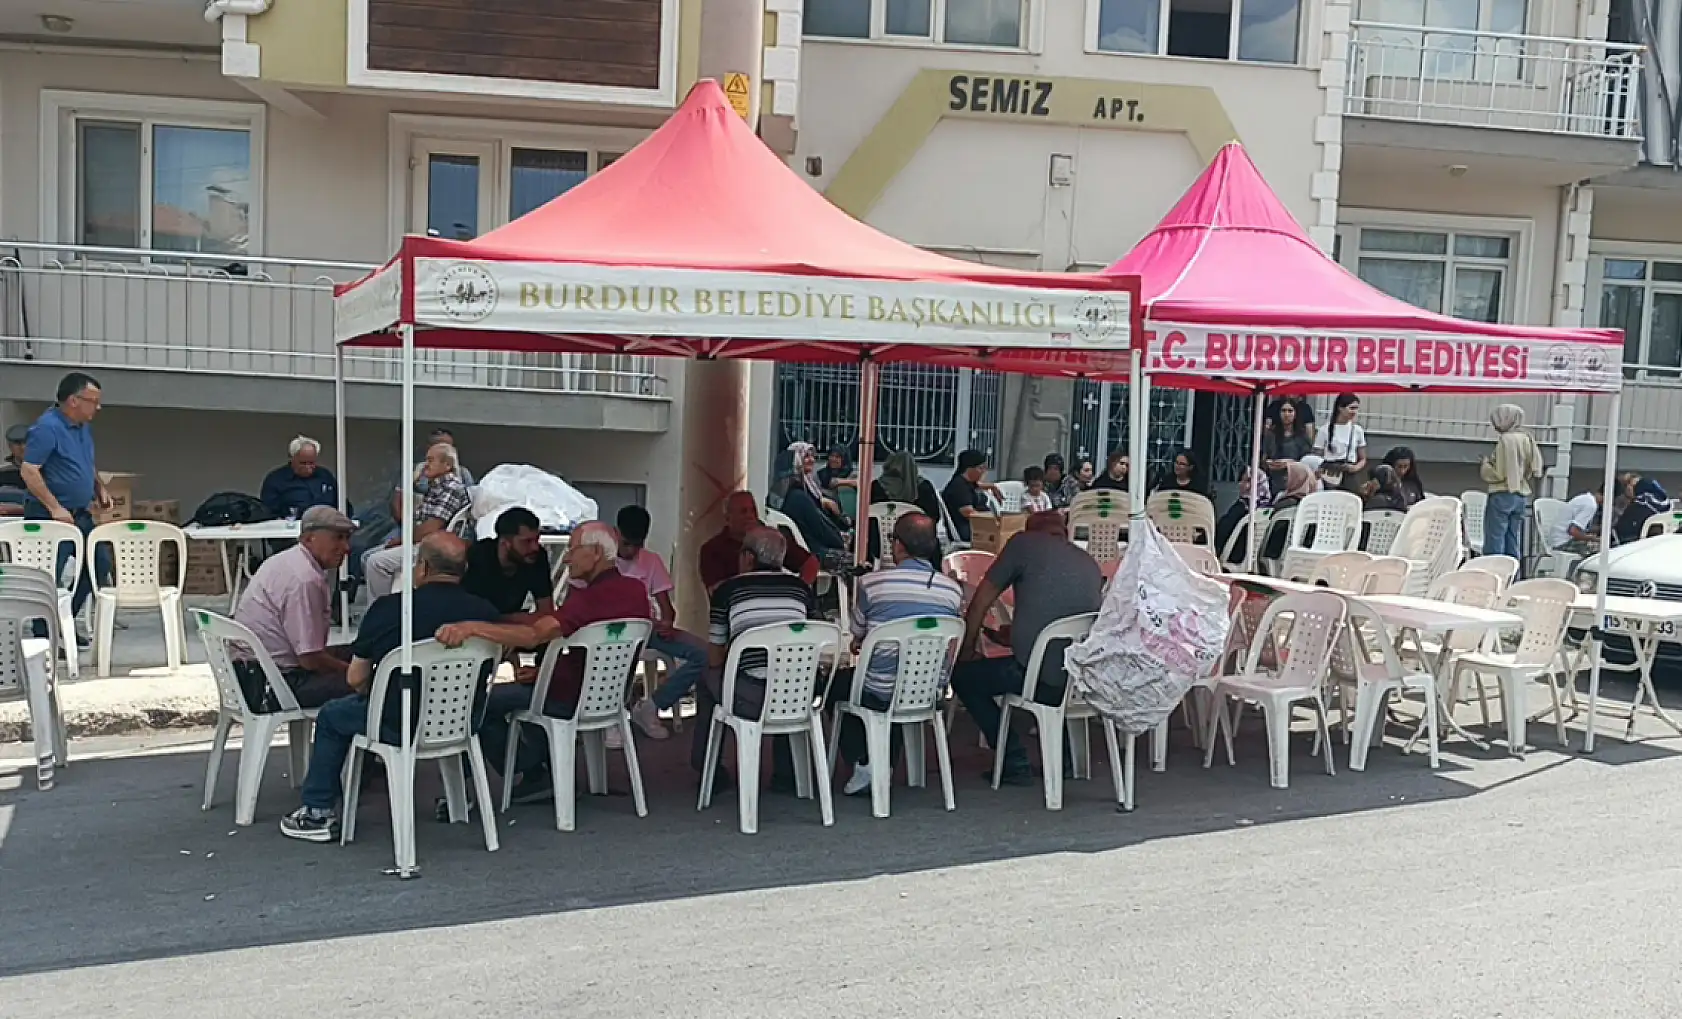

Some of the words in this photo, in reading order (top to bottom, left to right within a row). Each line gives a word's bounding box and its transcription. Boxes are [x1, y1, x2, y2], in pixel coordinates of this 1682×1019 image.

[1092, 97, 1145, 122] APT.
[518, 281, 681, 314] BURDUR
[694, 286, 857, 319] BELEDİYE
[867, 296, 1058, 329] BAŞKANLIĞI
[1141, 330, 1196, 369] T.C.
[1204, 333, 1348, 374] BURDUR
